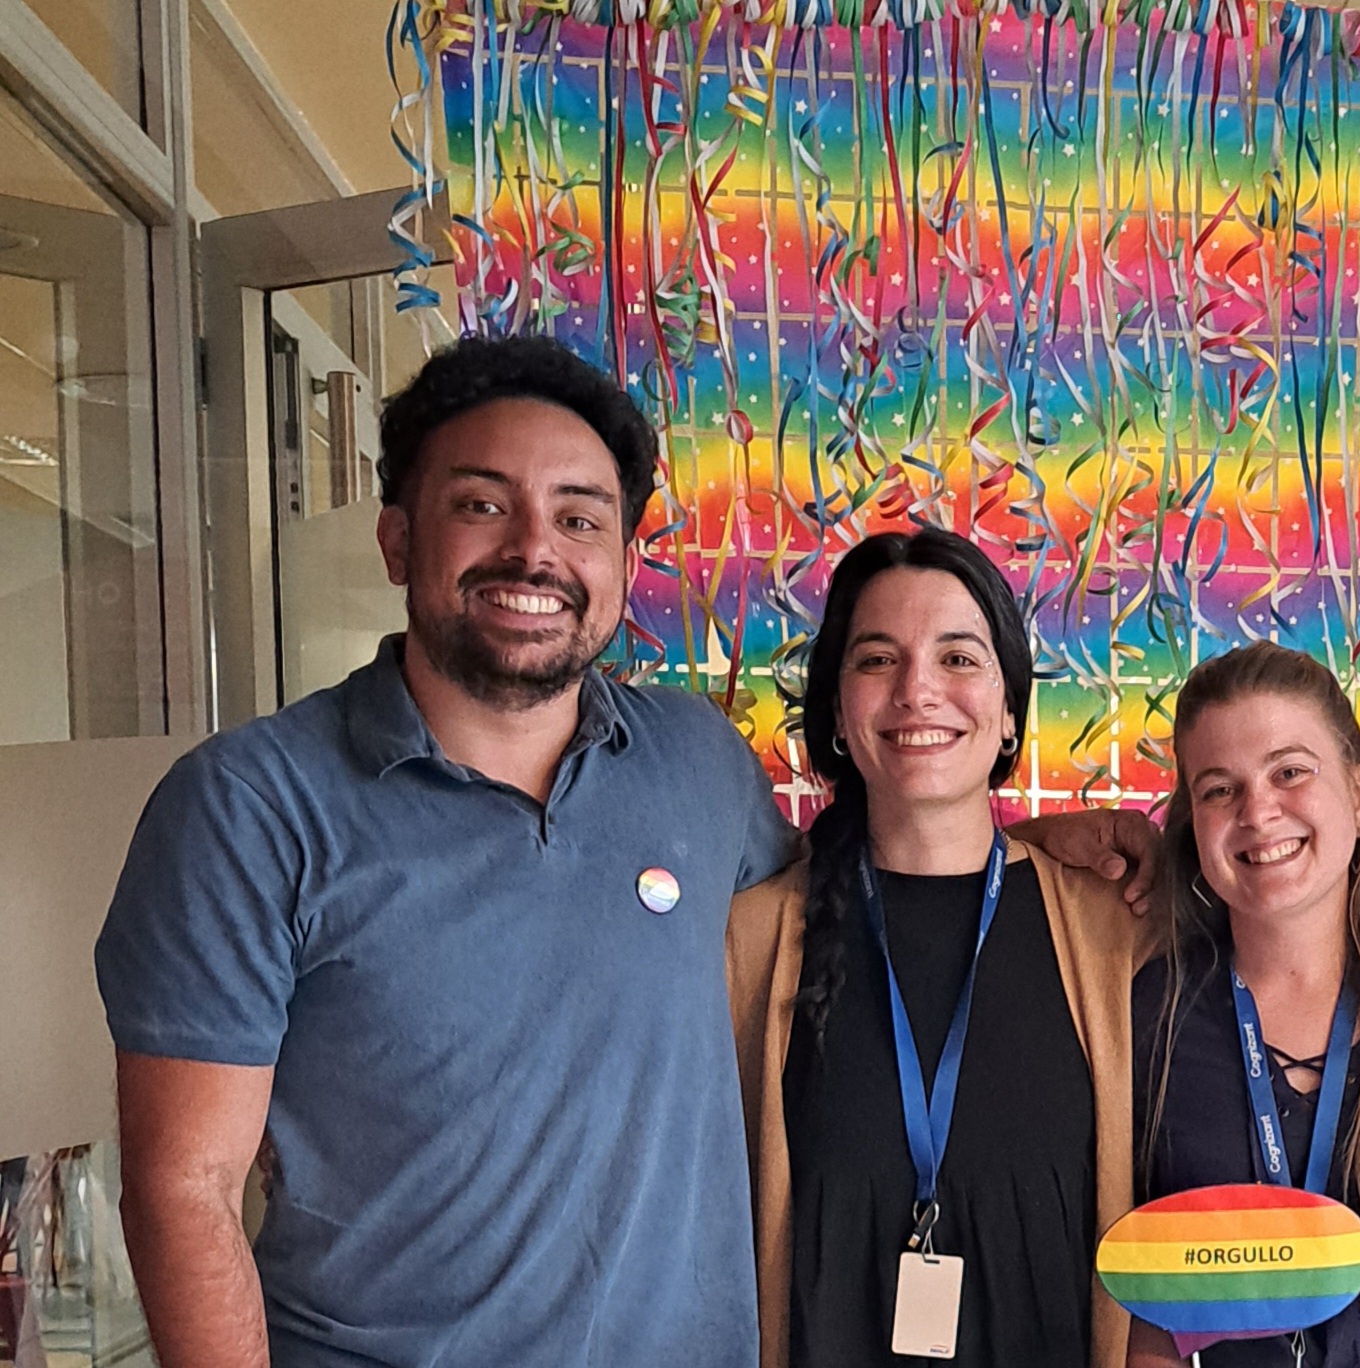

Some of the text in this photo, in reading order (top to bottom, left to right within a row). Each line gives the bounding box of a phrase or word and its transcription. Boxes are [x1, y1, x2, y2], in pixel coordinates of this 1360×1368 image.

[1243, 1022, 1263, 1078] Cognizant
[1260, 1114, 1281, 1173] Cognizant
[1184, 1245, 1294, 1266] #ORGULLO
